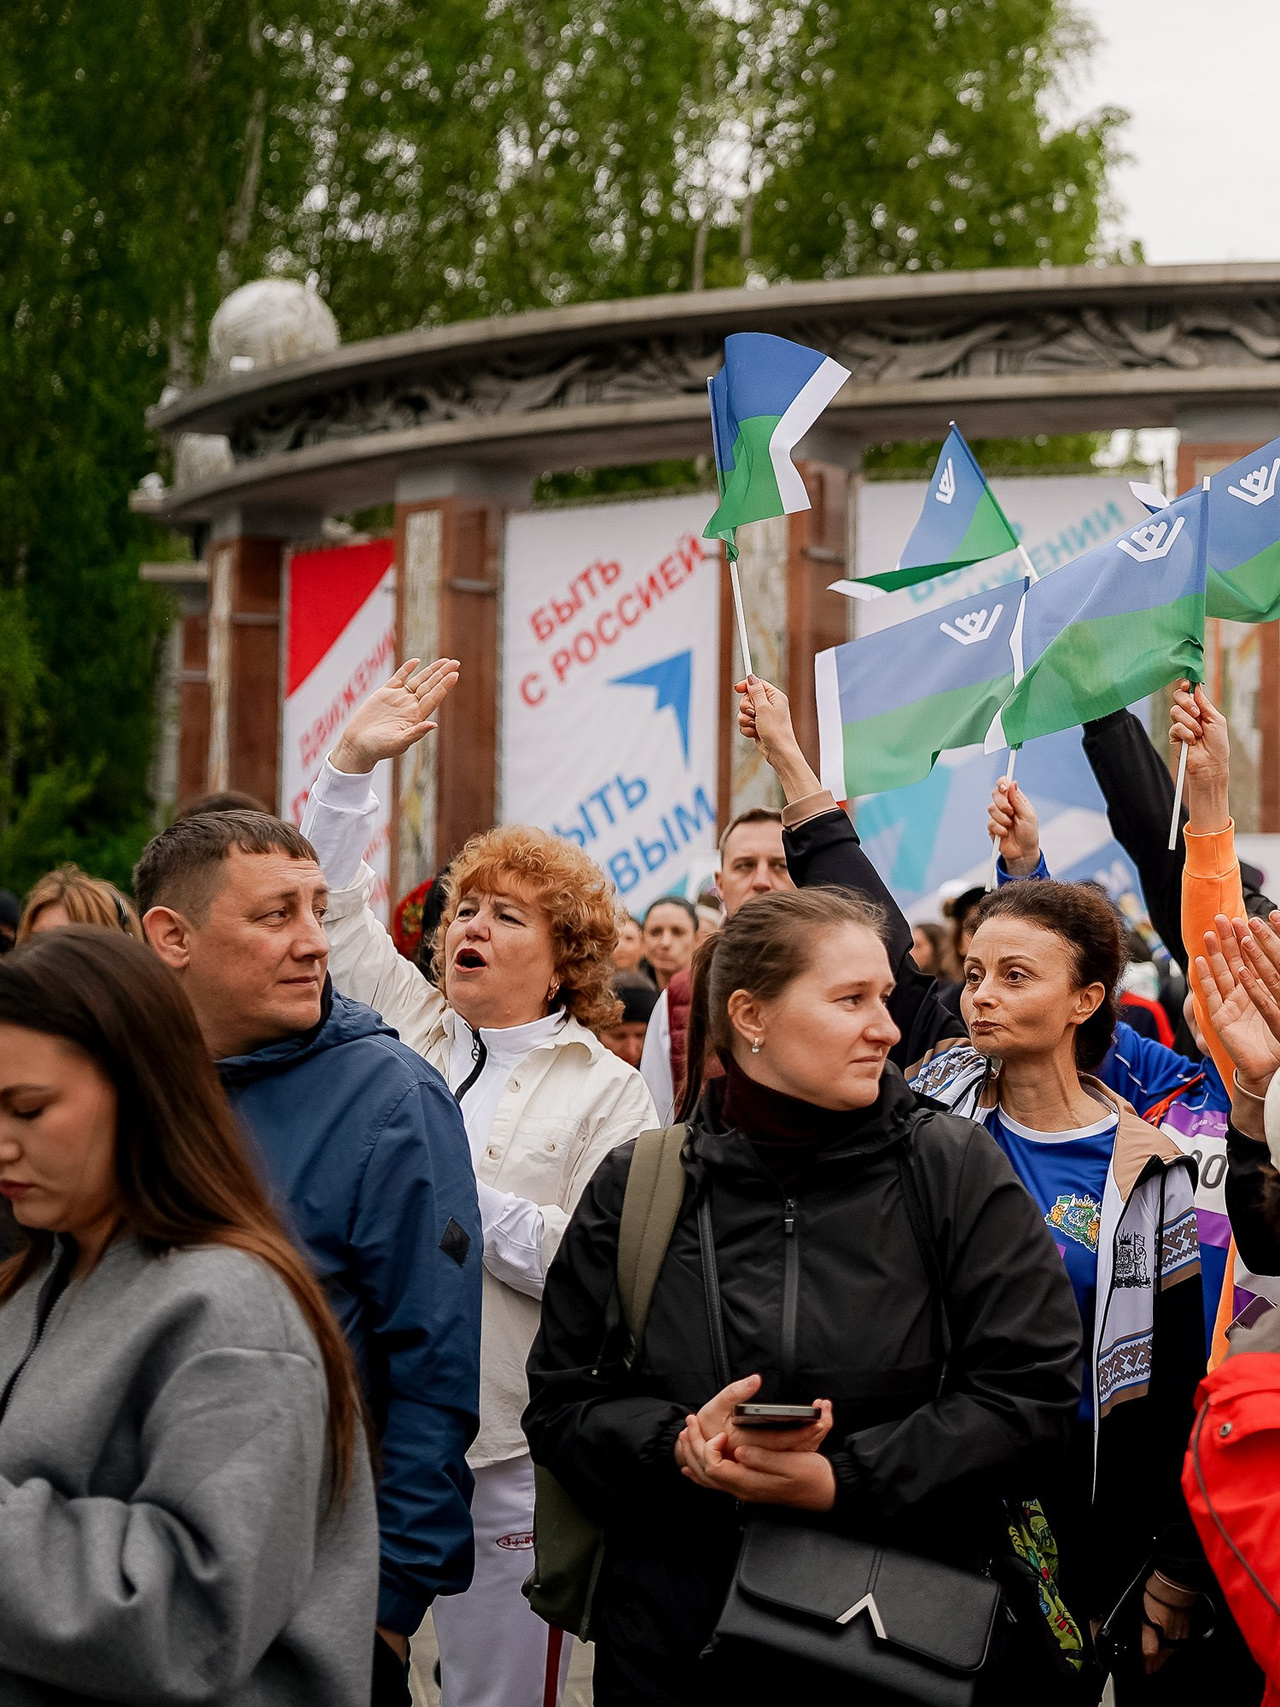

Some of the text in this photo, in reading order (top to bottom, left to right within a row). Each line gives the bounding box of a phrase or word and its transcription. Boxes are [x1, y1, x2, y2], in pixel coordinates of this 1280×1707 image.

[520, 533, 707, 708] С РОССИЕЙ
[529, 559, 622, 642] БЫТЬ
[553, 773, 648, 848] ЫТЬ
